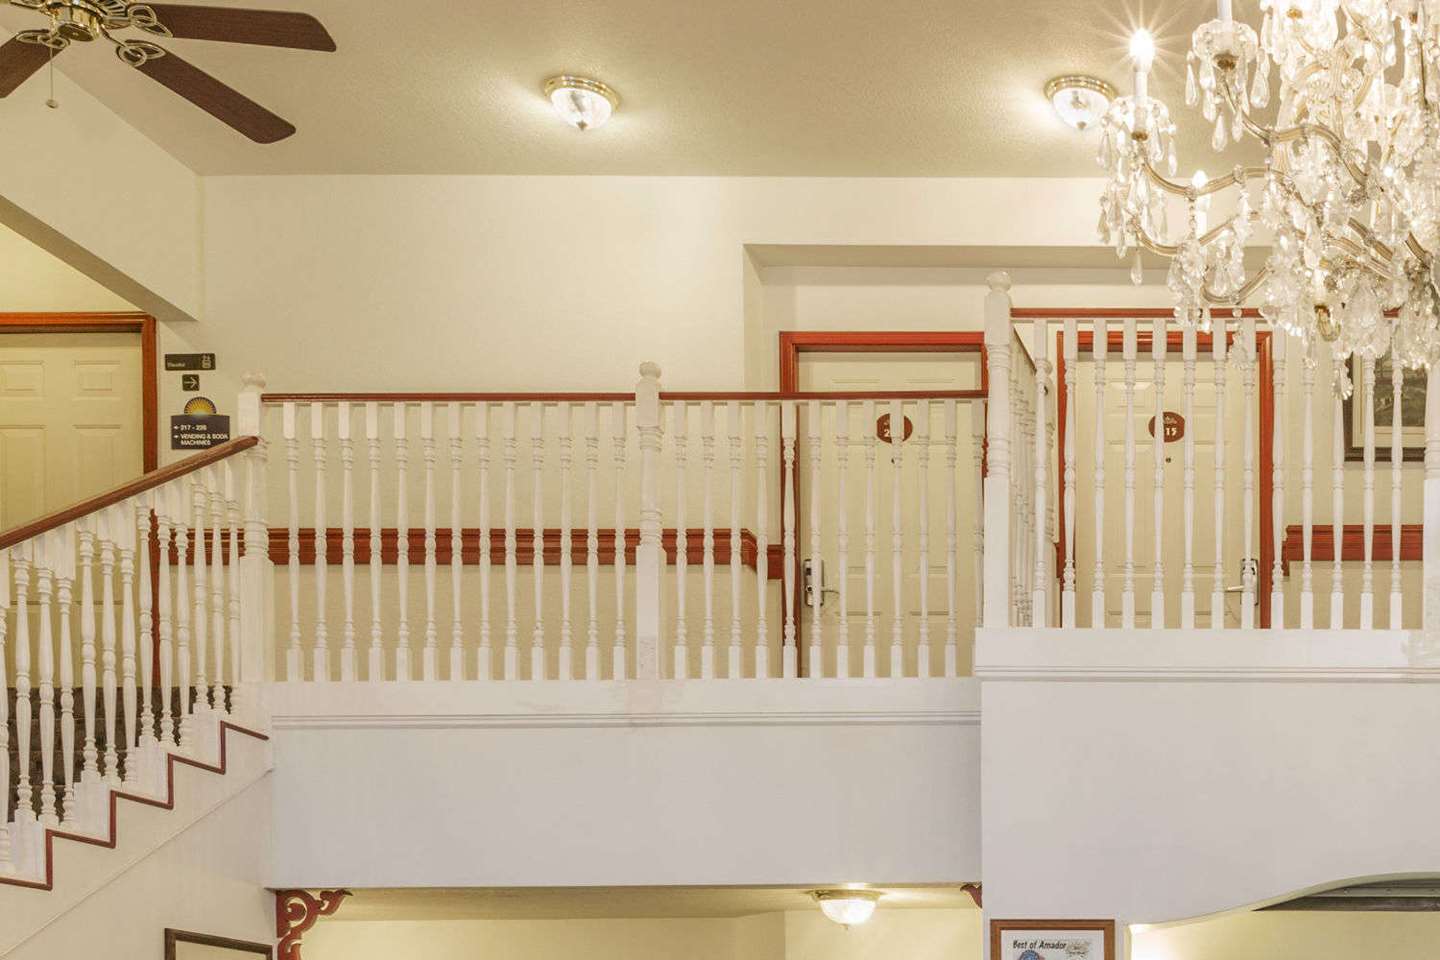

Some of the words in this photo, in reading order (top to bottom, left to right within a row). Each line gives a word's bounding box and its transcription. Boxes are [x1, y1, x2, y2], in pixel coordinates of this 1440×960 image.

[1013, 940, 1028, 949] Best
[1029, 940, 1036, 949] of
[1038, 940, 1067, 949] Amador
